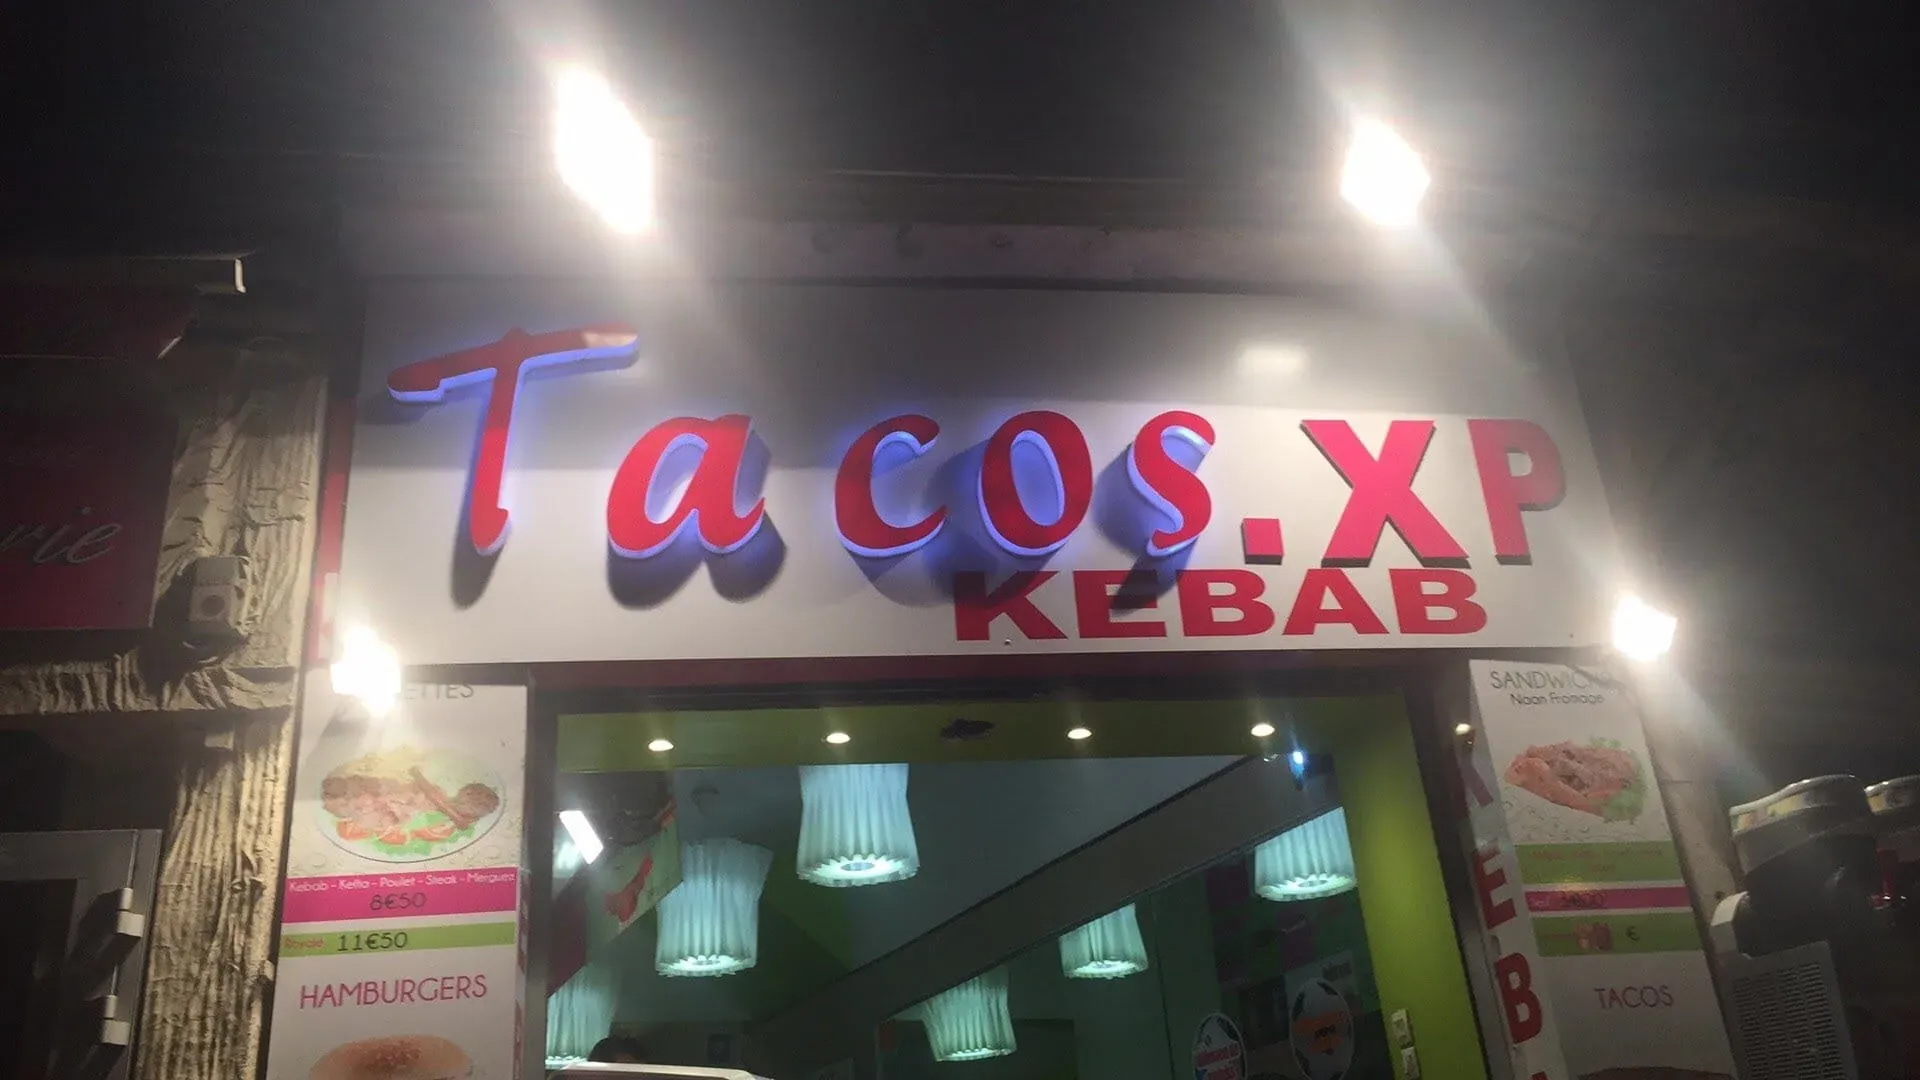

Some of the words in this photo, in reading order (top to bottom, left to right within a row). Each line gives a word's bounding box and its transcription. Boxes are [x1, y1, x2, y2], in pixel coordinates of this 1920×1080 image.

[953, 568, 1488, 641] KEBAB
[289, 882, 329, 892] Kebab
[369, 892, 427, 911] 8€50
[338, 931, 408, 951] 11€50
[299, 974, 488, 1009] HAMBURGERS
[1593, 985, 1674, 1009] TACOS
